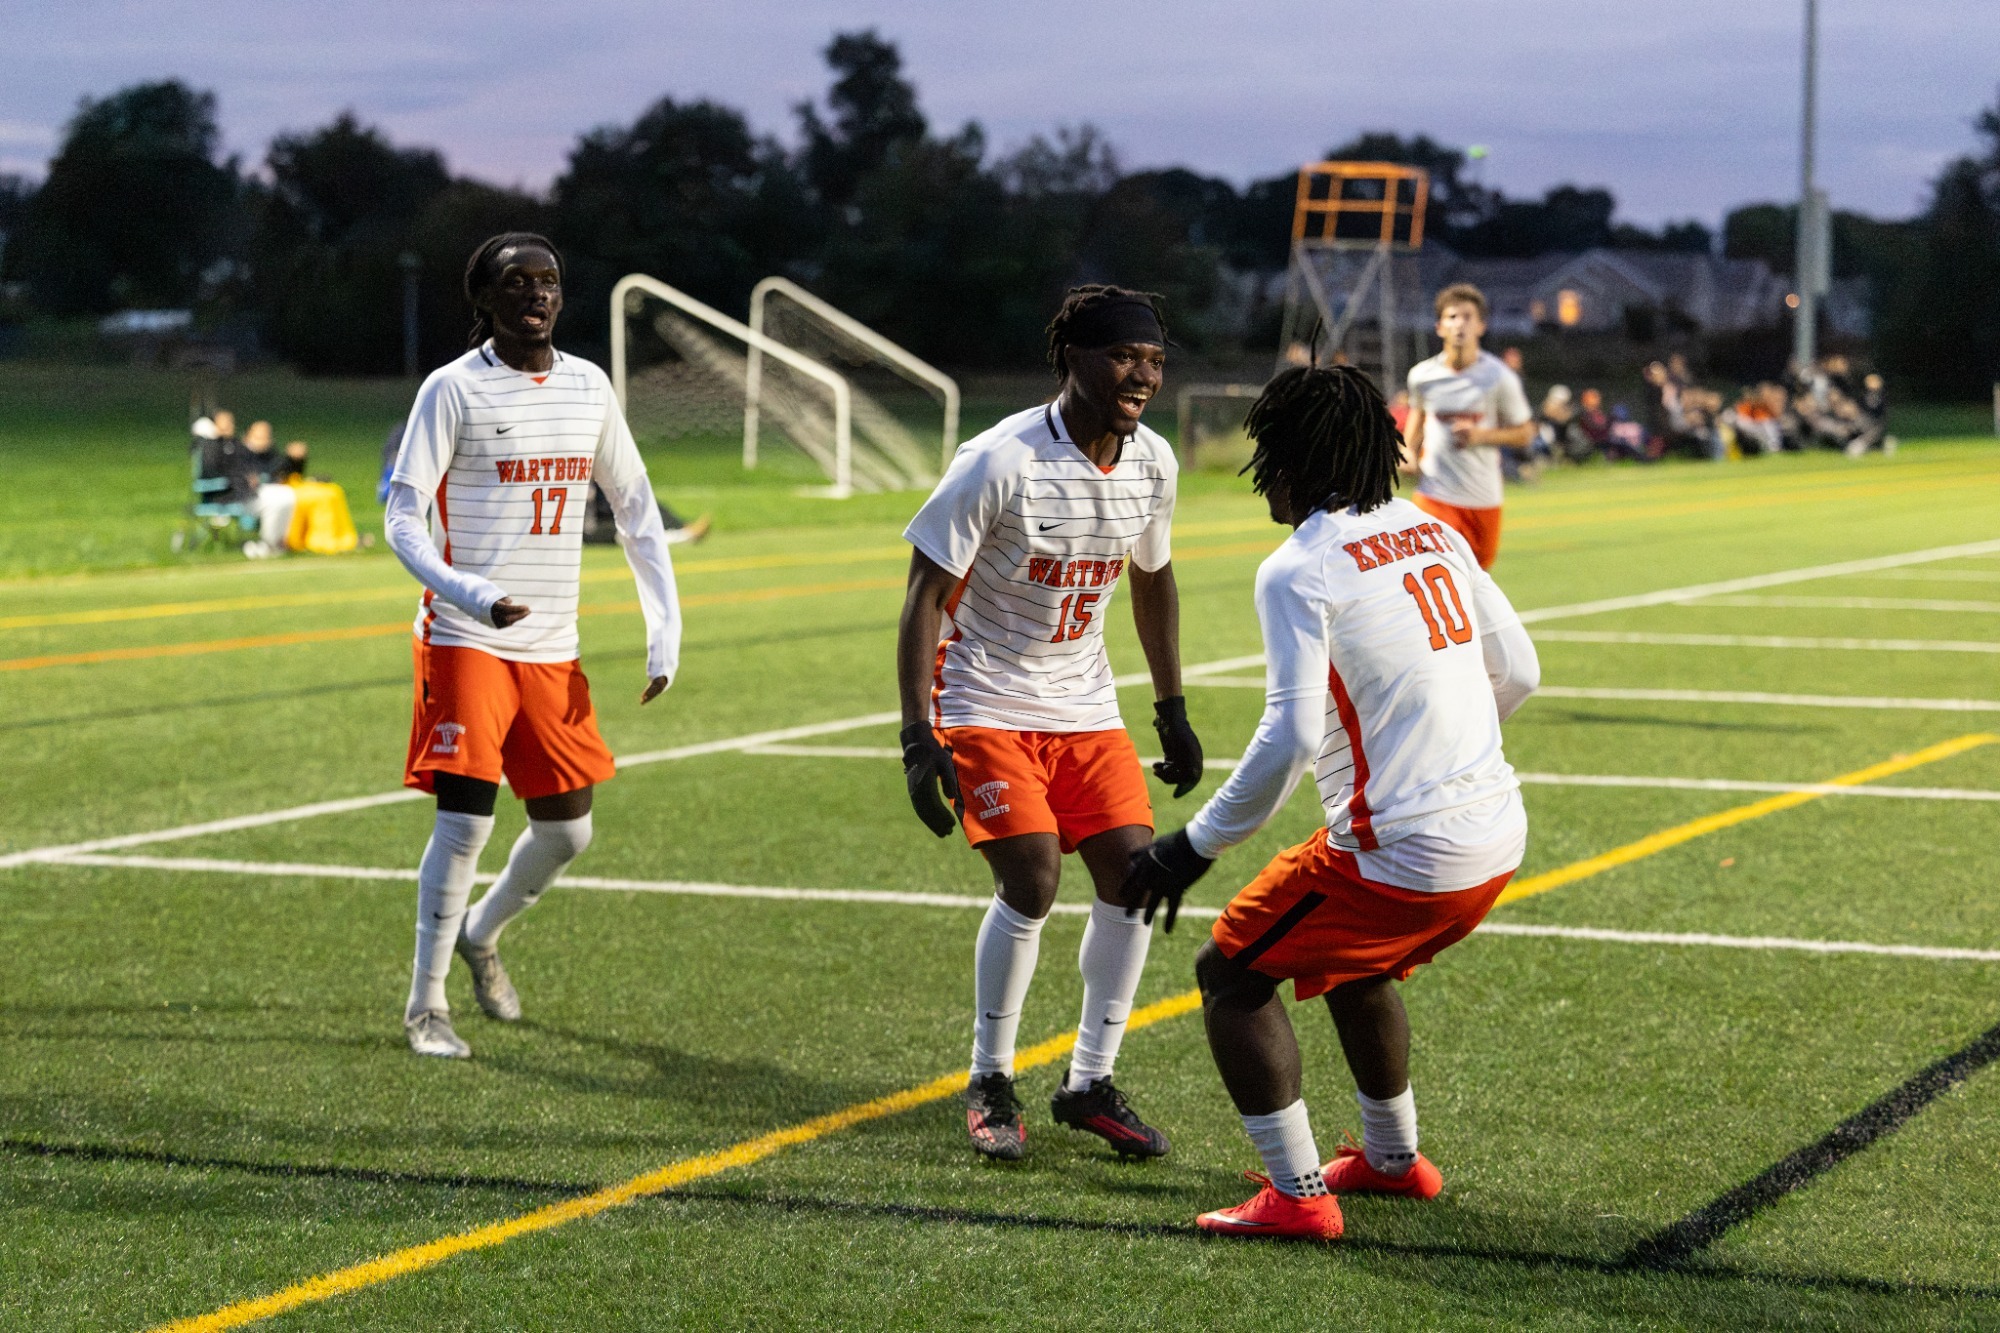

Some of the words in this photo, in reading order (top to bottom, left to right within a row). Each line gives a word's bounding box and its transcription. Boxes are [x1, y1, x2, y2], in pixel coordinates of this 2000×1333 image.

[495, 457, 593, 483] WARTBUR
[529, 487, 567, 535] 17
[1050, 593, 1101, 643] 15
[1403, 563, 1472, 651] 10
[980, 789, 1001, 808] W
